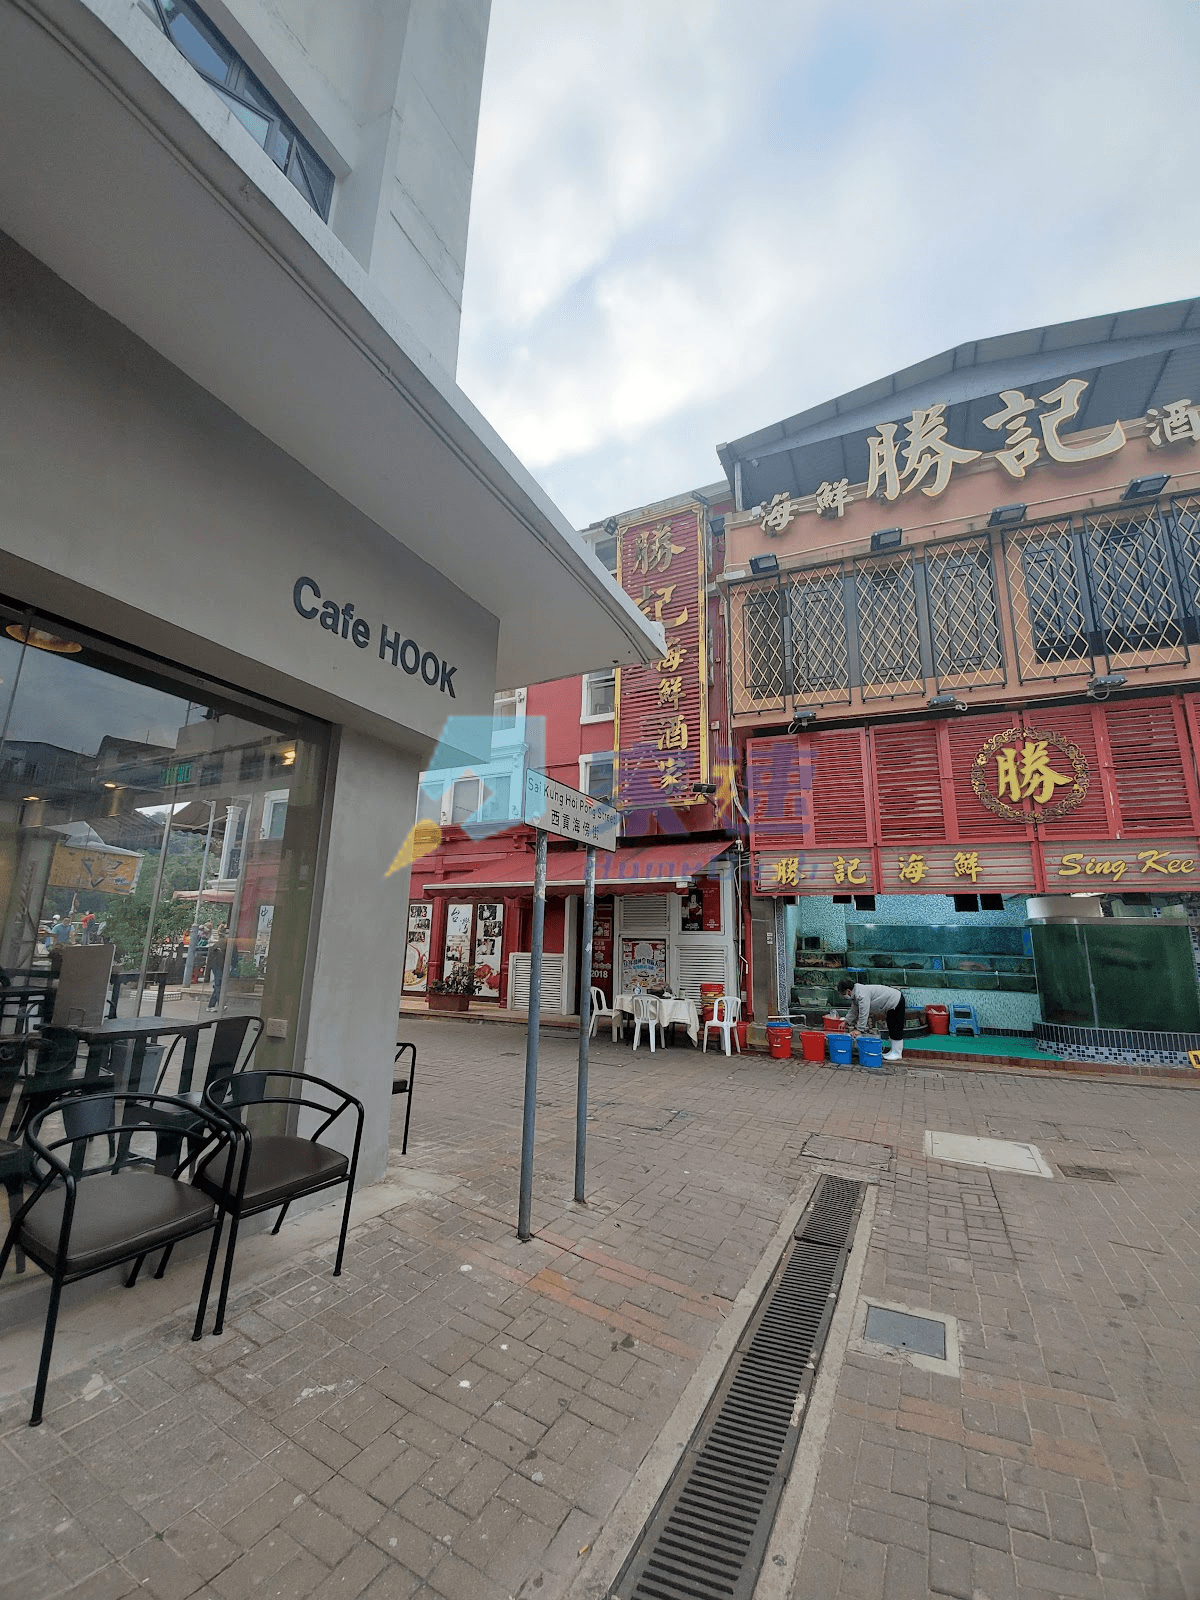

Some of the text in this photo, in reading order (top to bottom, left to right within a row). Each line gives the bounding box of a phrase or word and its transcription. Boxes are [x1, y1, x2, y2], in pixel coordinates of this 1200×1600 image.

[293, 576, 457, 698] Cafe HOOK
[996, 740, 1073, 804] 勝
[528, 777, 542, 793] Sai
[543, 784, 564, 807] Kung
[565, 793, 578, 810] Hoi
[597, 807, 617, 825] Street
[1058, 850, 1197, 881] Sing Kee
[591, 970, 608, 978] 2018
